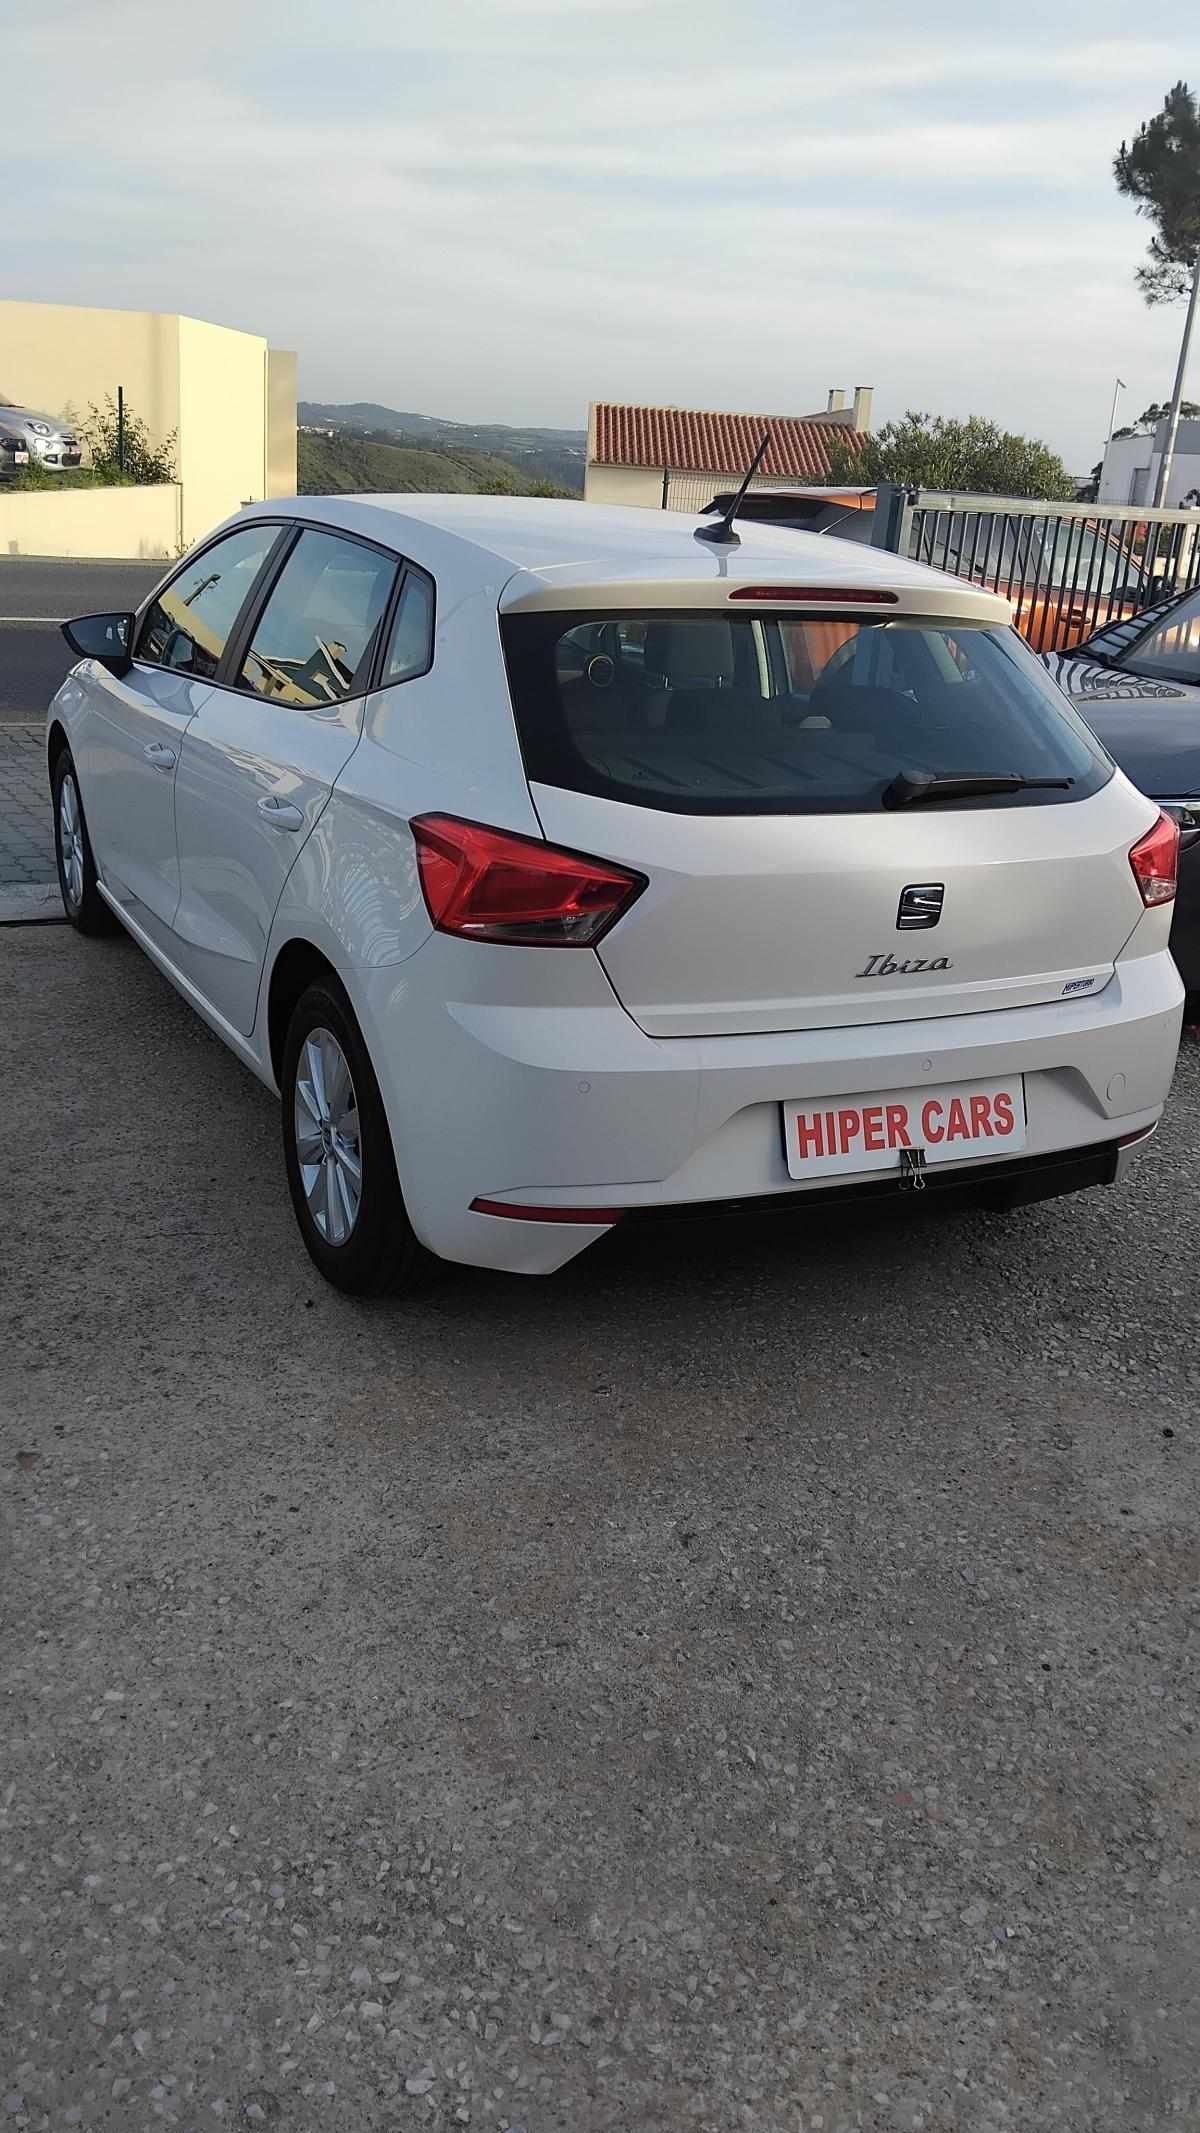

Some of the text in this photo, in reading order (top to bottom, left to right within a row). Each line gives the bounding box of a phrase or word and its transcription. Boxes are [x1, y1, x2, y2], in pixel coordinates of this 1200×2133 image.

[854, 953, 953, 978] Ibiza
[797, 1092, 1015, 1159] HIPER CARS
